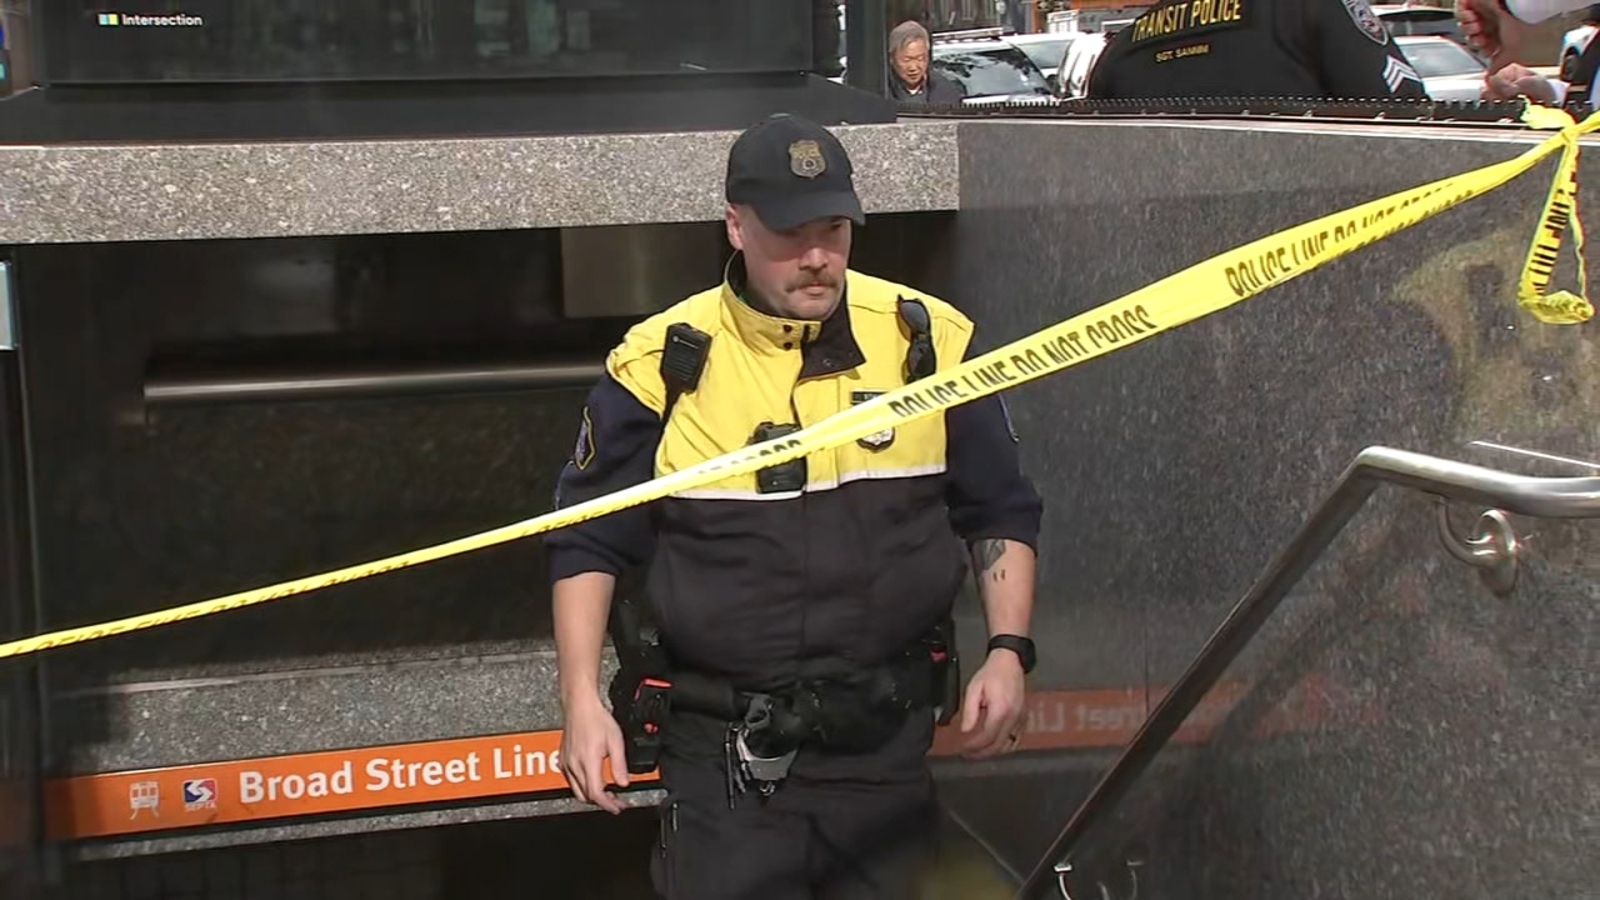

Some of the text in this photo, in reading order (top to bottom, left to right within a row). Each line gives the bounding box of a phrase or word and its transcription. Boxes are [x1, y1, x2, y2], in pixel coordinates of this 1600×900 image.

[121, 13, 203, 26] Intersection
[1131, 0, 1241, 42] TRANSIT POLICE
[239, 760, 354, 804] Broad
[365, 752, 481, 791] Street
